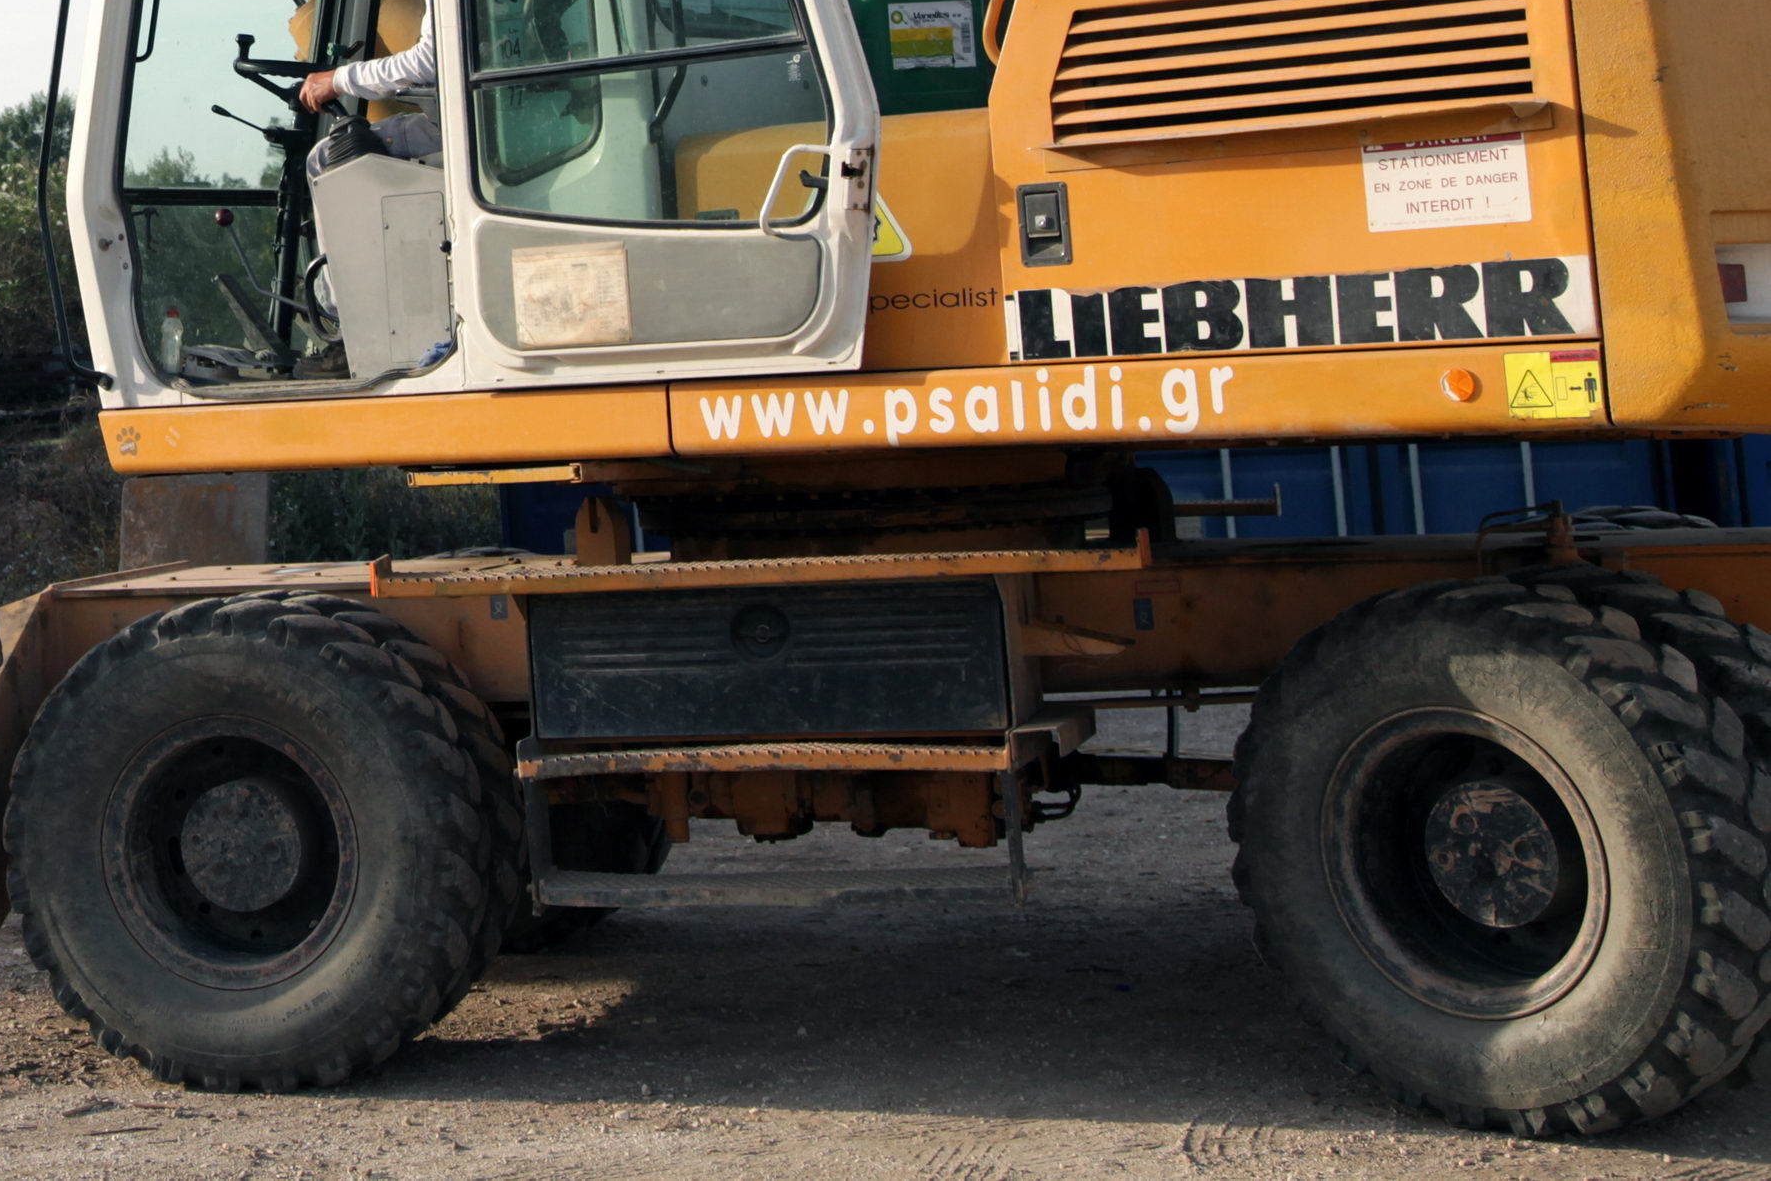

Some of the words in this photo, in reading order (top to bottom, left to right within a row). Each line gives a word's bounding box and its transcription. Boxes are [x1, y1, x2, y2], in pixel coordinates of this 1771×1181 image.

[1378, 148, 1509, 171] STATIONNEMENT
[1374, 183, 1390, 193] EN
[1399, 179, 1432, 192] ZONE
[1441, 176, 1457, 188] DE
[1466, 172, 1518, 186] DANGER
[1406, 197, 1474, 214] INTERDIT
[869, 287, 999, 315] pecialist
[1018, 256, 1576, 361] LIEBHERR
[700, 365, 1233, 447] www.psalidi.gr
